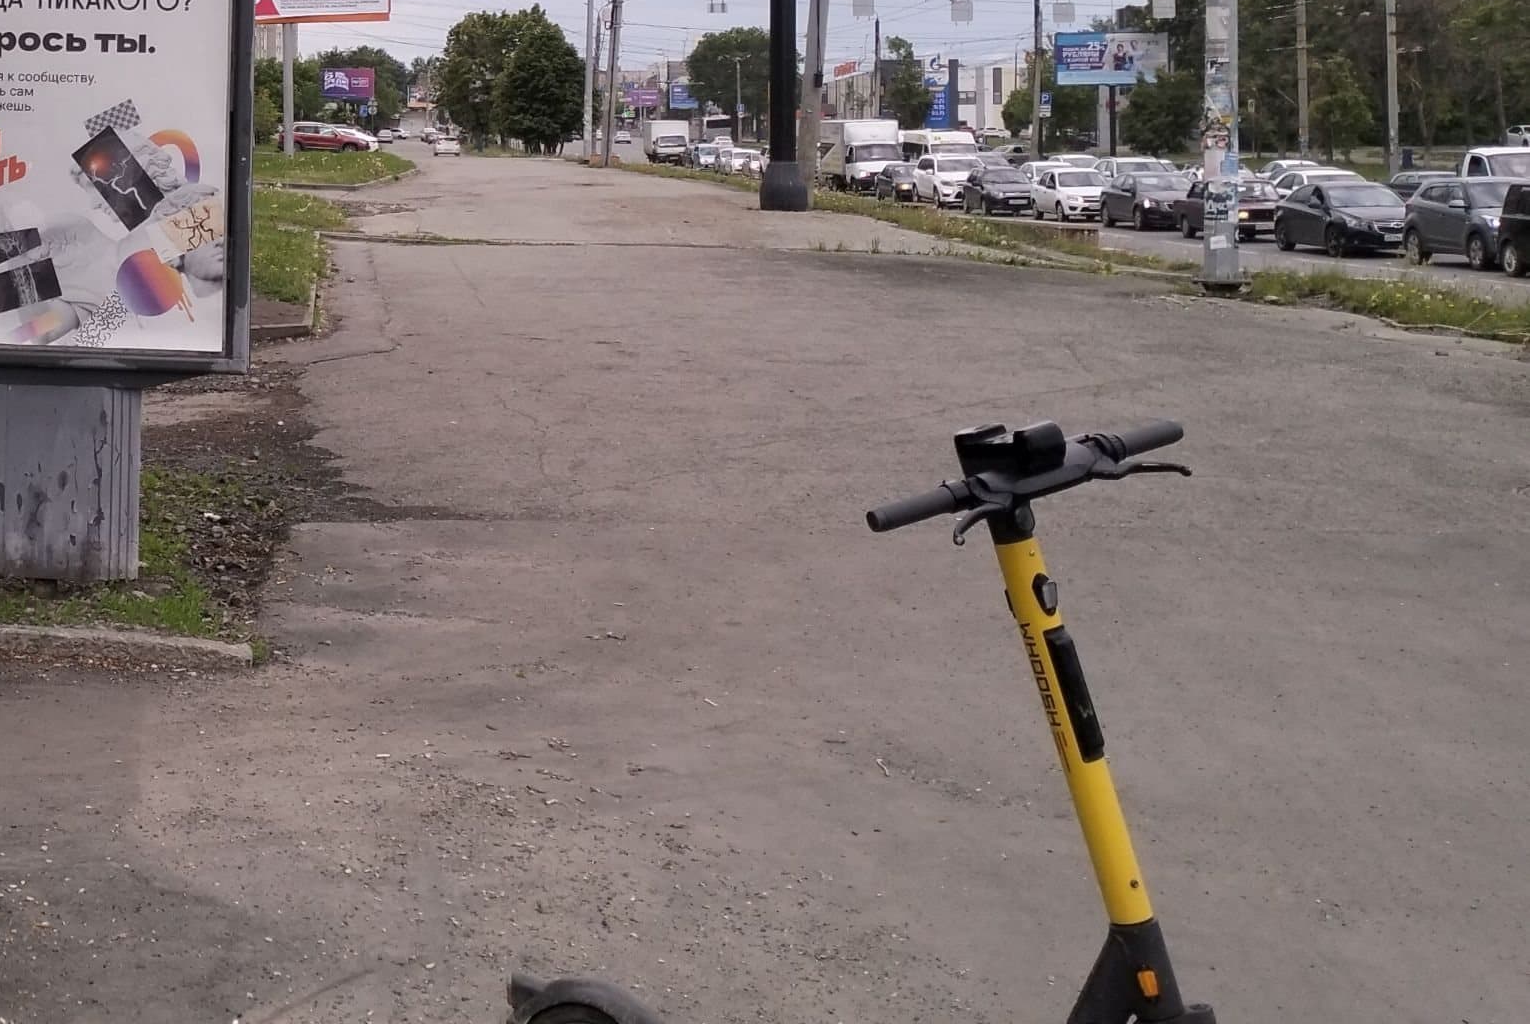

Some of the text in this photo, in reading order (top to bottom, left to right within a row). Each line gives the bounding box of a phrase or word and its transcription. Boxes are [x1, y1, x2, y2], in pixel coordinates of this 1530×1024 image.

[94, 32, 156, 54] ты.
[17, 72, 97, 86] сообществу.
[9, 88, 34, 97] сам
[1019, 622, 1062, 727] WHOOSH
